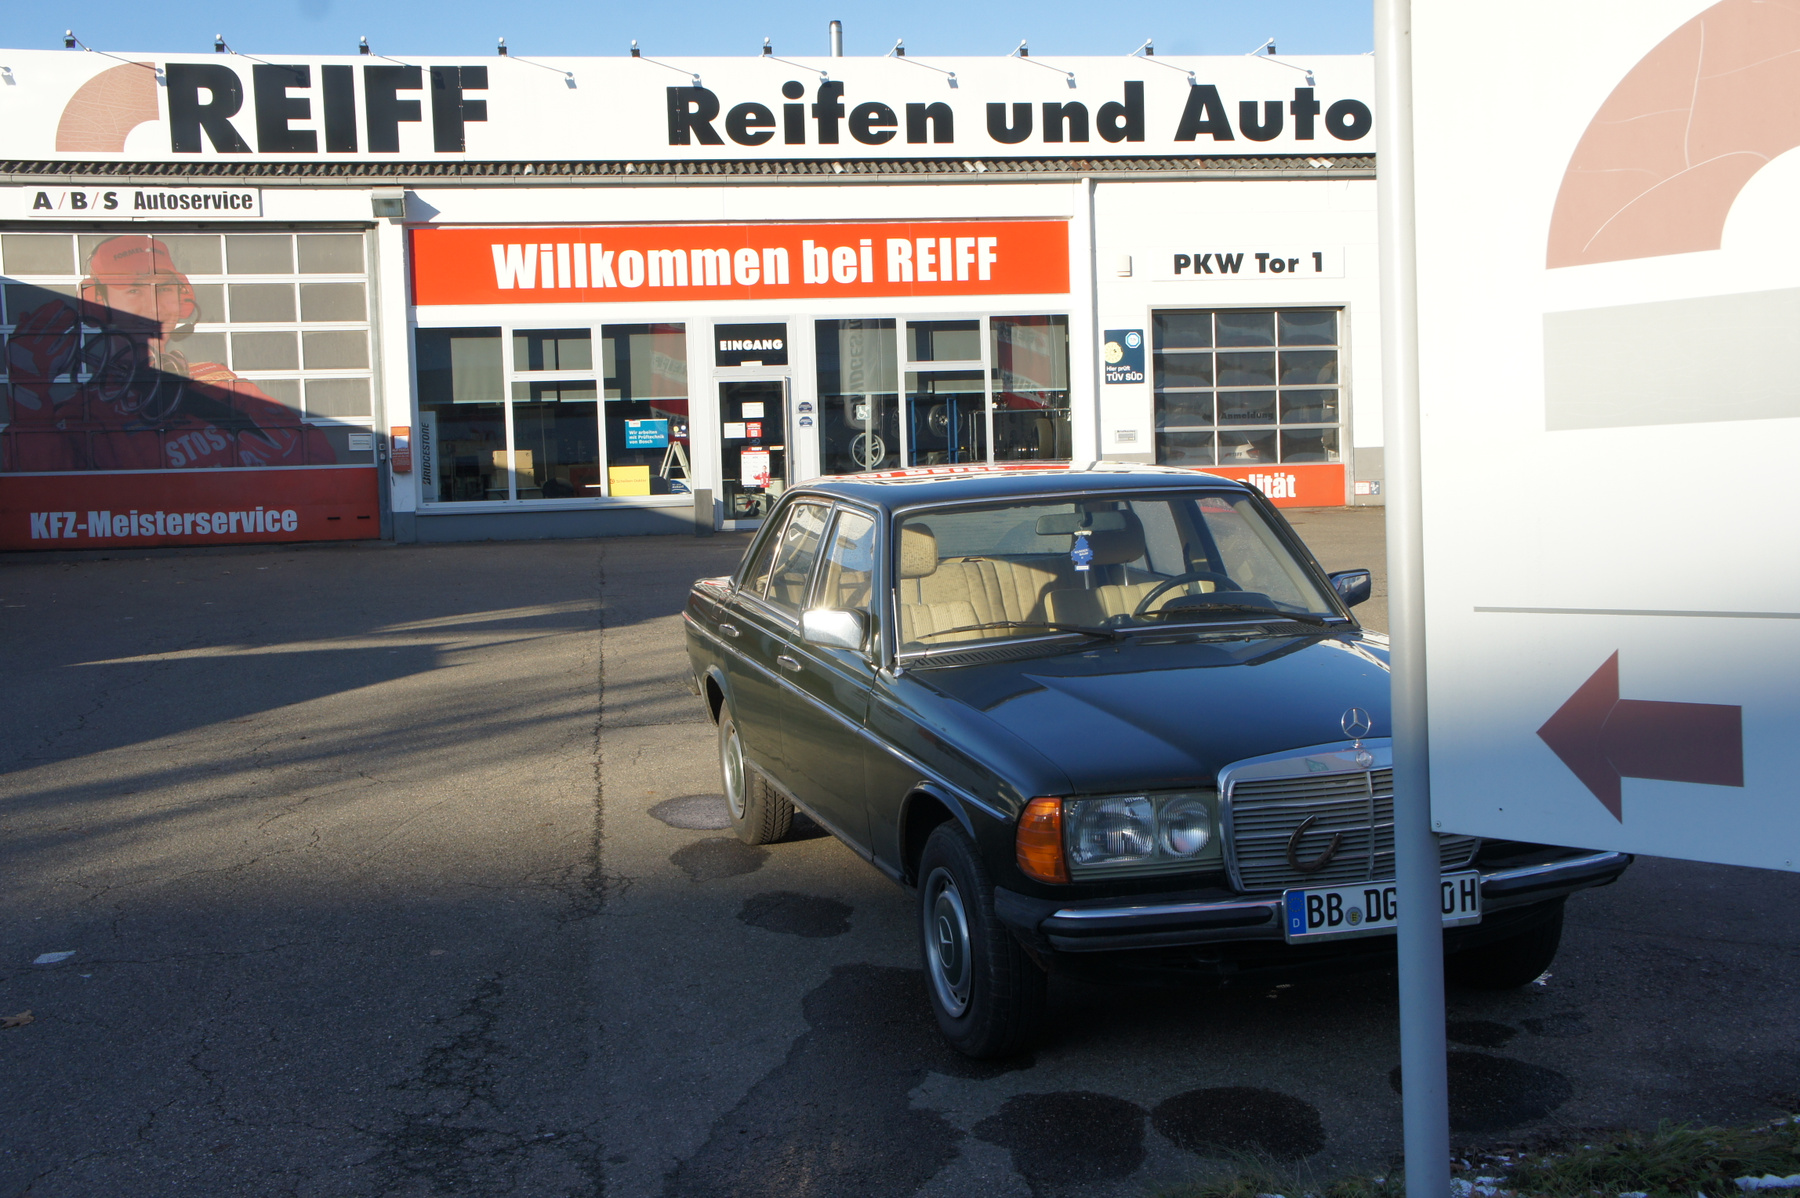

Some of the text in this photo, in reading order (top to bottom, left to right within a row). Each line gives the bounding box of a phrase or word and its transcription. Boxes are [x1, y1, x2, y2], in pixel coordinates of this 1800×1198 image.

[165, 63, 489, 153] REIFF
[667, 80, 1373, 145] Reifen und Auto
[133, 191, 253, 210] Autoservice
[491, 236, 998, 290] Willkommen bei REIFF
[1174, 252, 1323, 274] PKW Tor 1
[719, 338, 783, 352] EINGANG
[1106, 371, 1143, 382] TÜV SÜD
[166, 425, 234, 467] STOS
[421, 421, 432, 486] BRIDGESTONE
[1237, 472, 1296, 498] lität
[30, 505, 298, 539] KFZ-Meisterservice
[1293, 918, 1300, 928] D
[1306, 893, 1344, 928] BB
